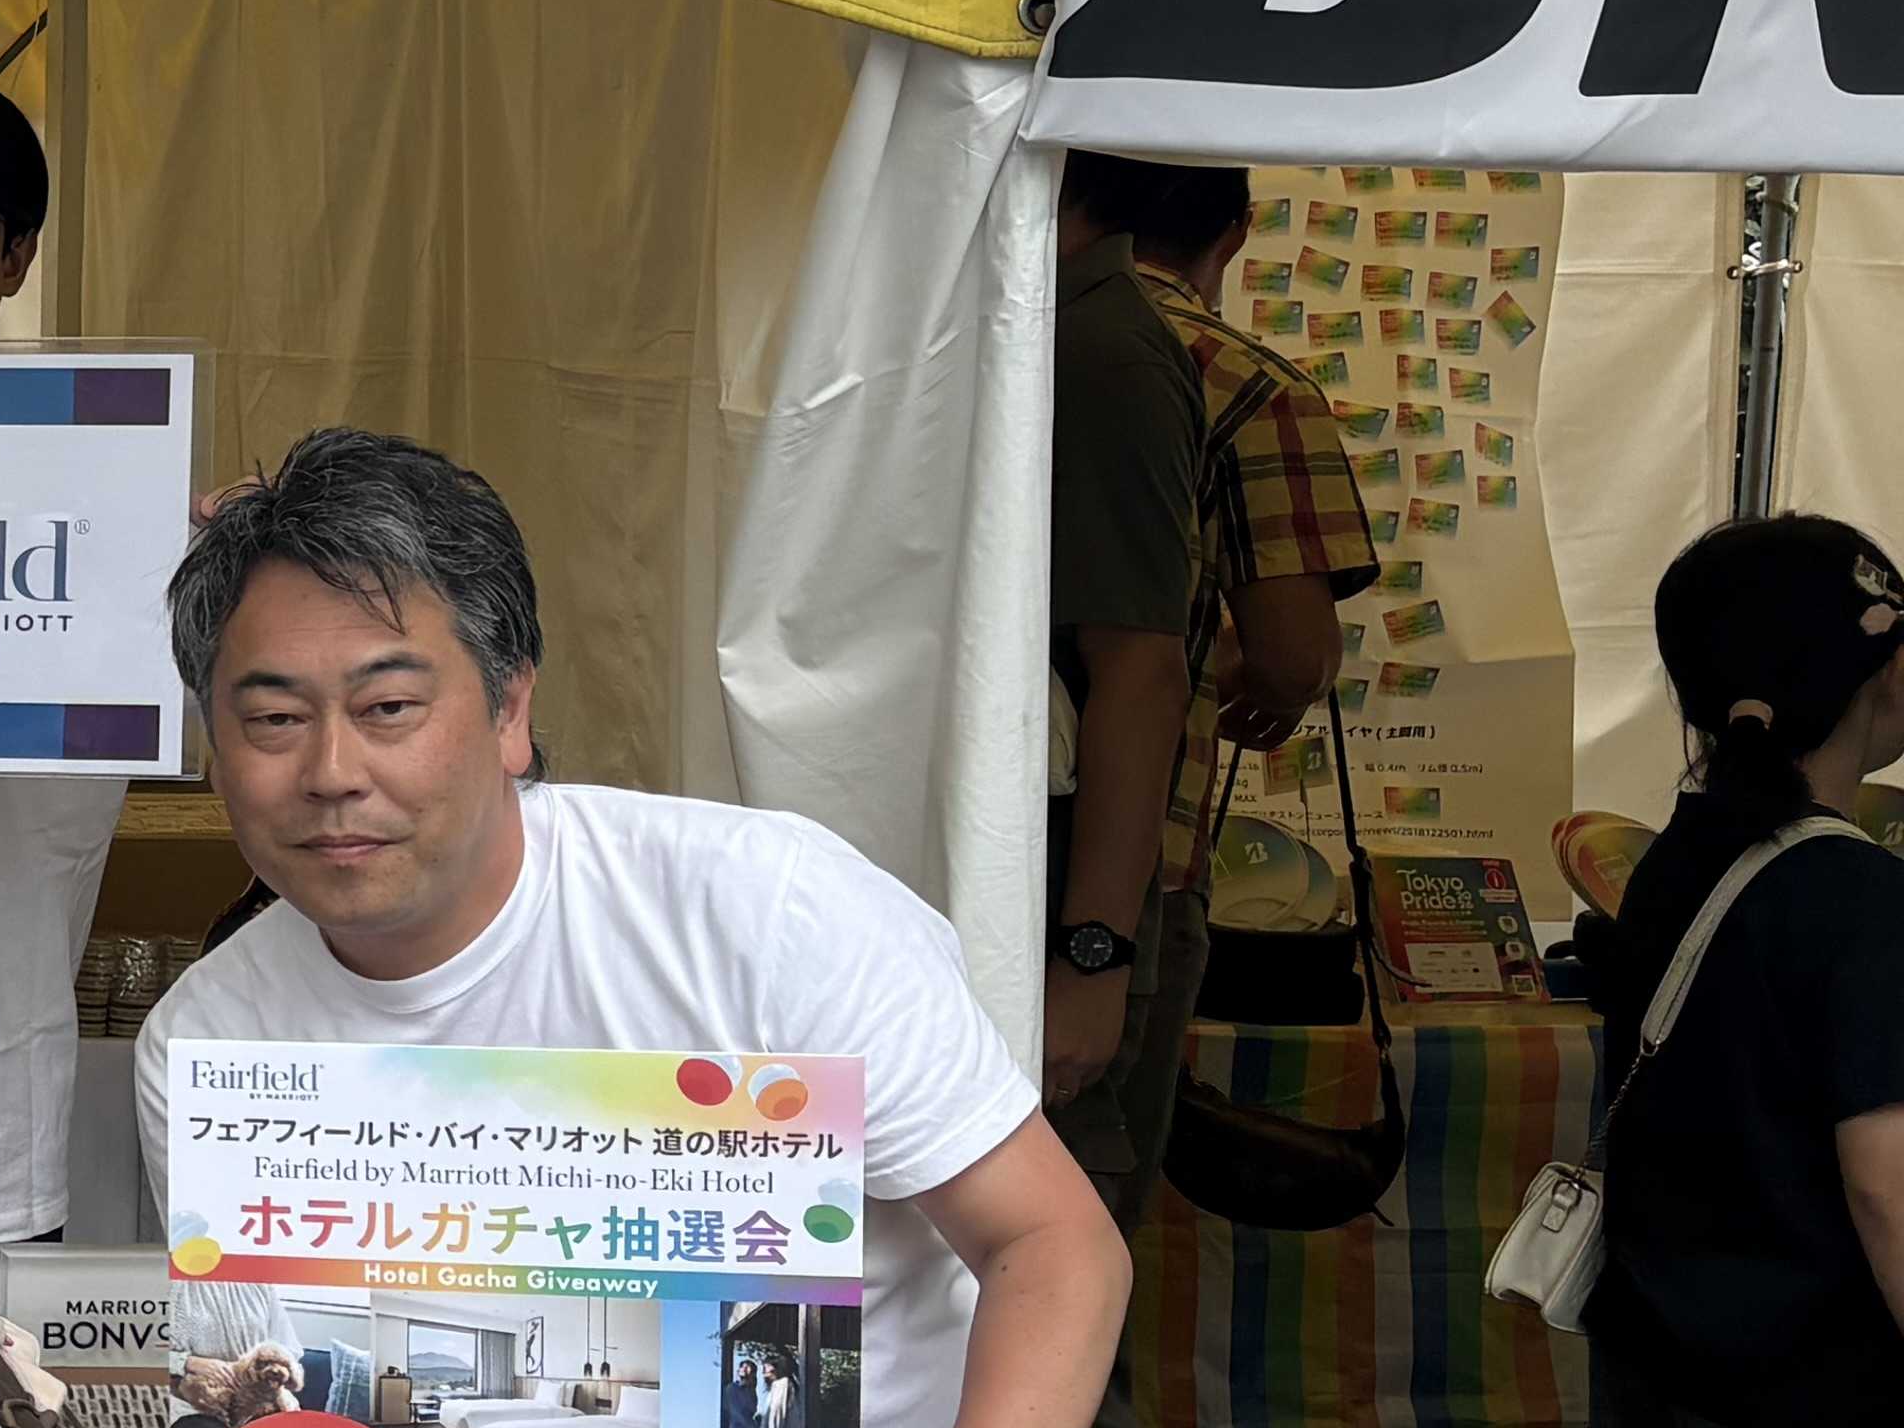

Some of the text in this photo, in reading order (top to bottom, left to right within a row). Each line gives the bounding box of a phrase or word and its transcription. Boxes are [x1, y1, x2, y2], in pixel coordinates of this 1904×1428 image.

[1397, 869, 1464, 895] Tokyo
[1400, 890, 1456, 911] Pride
[256, 1156, 357, 1179] Fairfield
[402, 1160, 509, 1184] Marriott
[237, 1195, 791, 1266] ホテルガチャ抽選会
[524, 1268, 657, 1298] Giveaway
